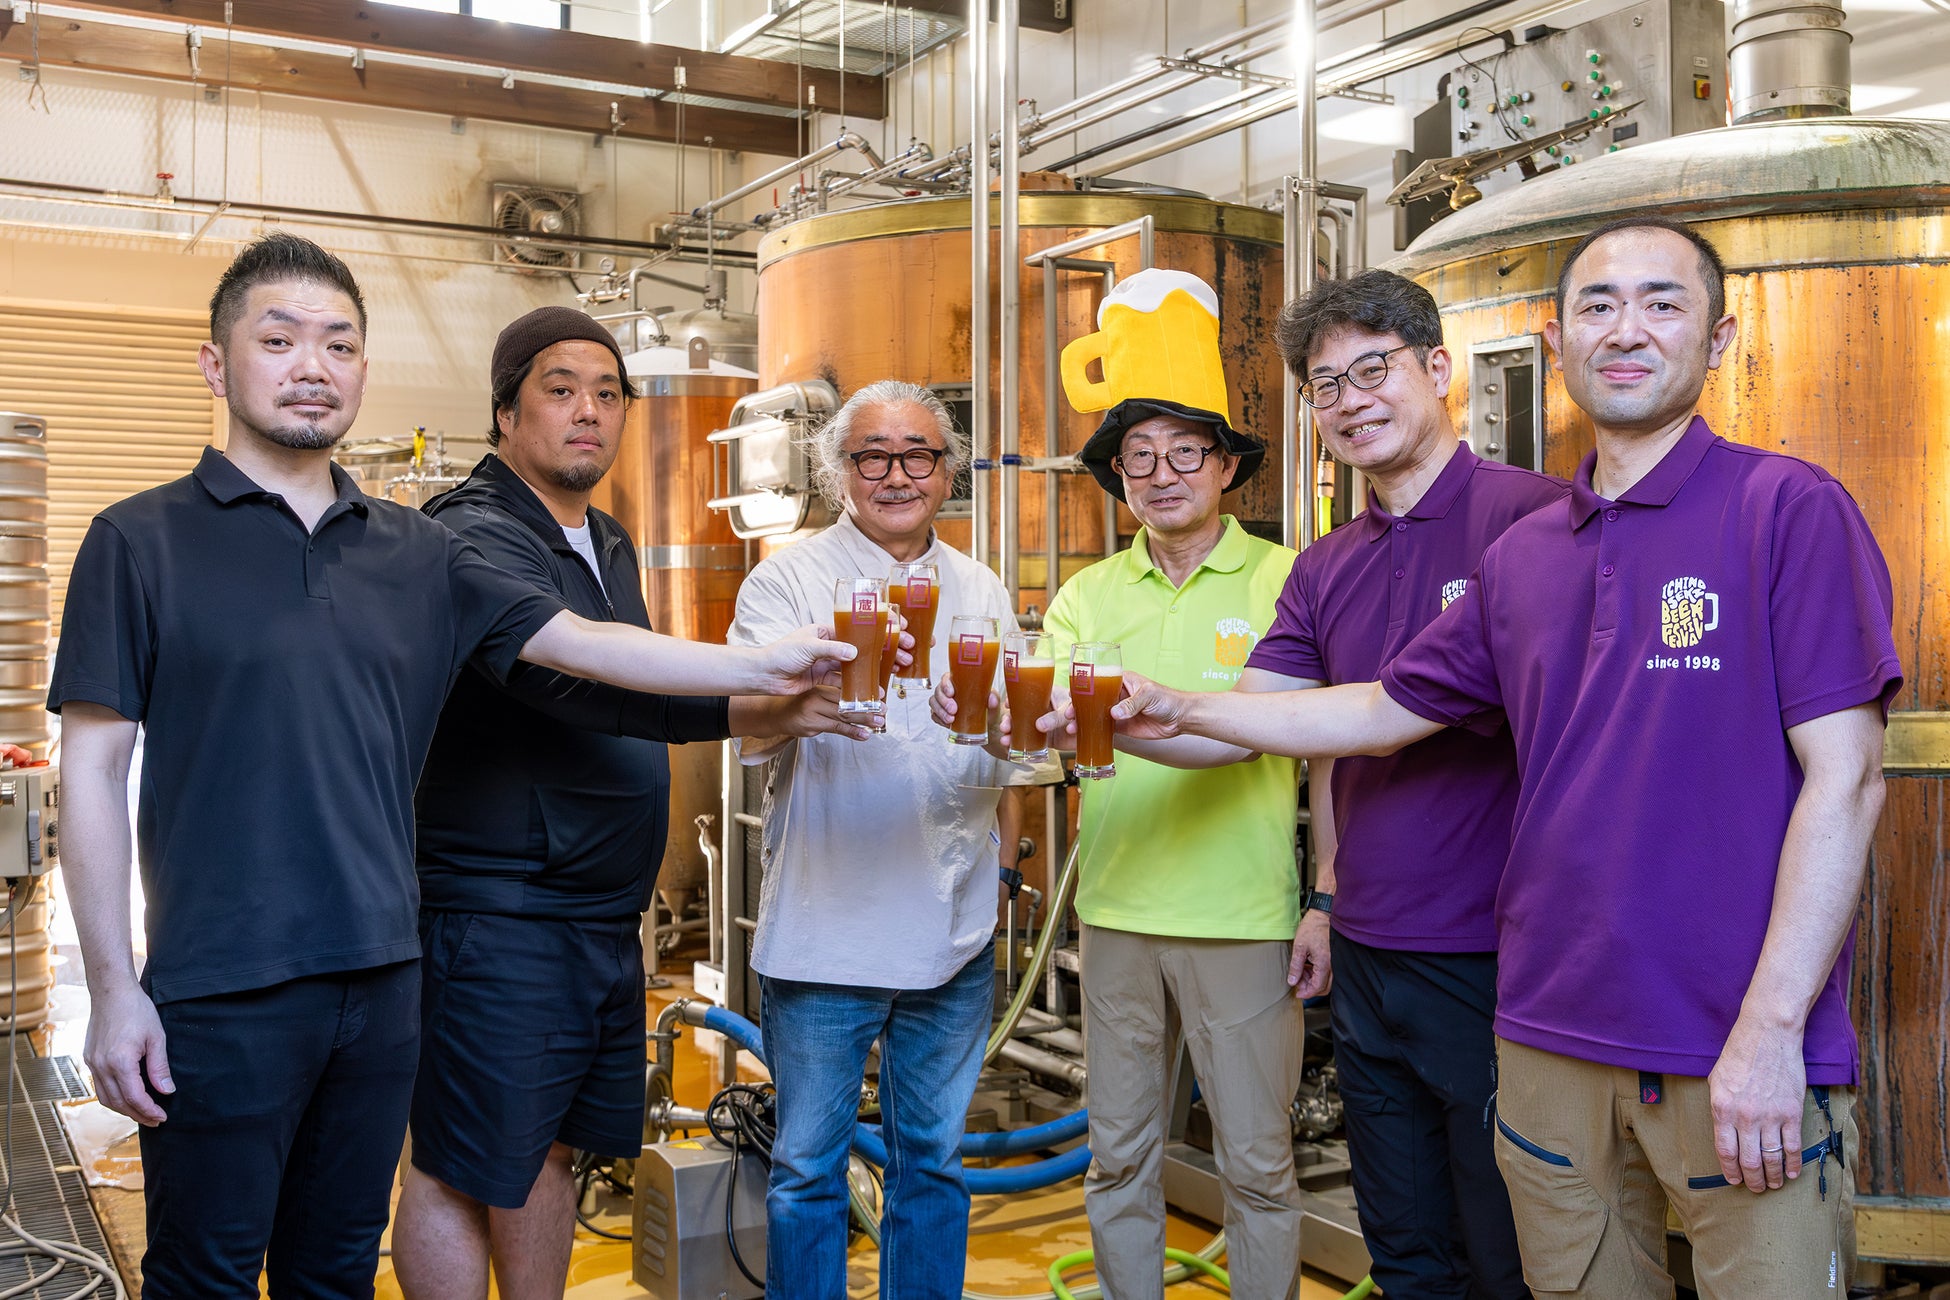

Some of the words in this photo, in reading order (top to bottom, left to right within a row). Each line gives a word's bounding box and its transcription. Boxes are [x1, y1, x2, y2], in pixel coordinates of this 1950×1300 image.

[1662, 577, 1706, 599] ICHINO
[1661, 598, 1704, 623] BEER
[1646, 655, 1680, 669] since
[1684, 655, 1721, 671] 1998
